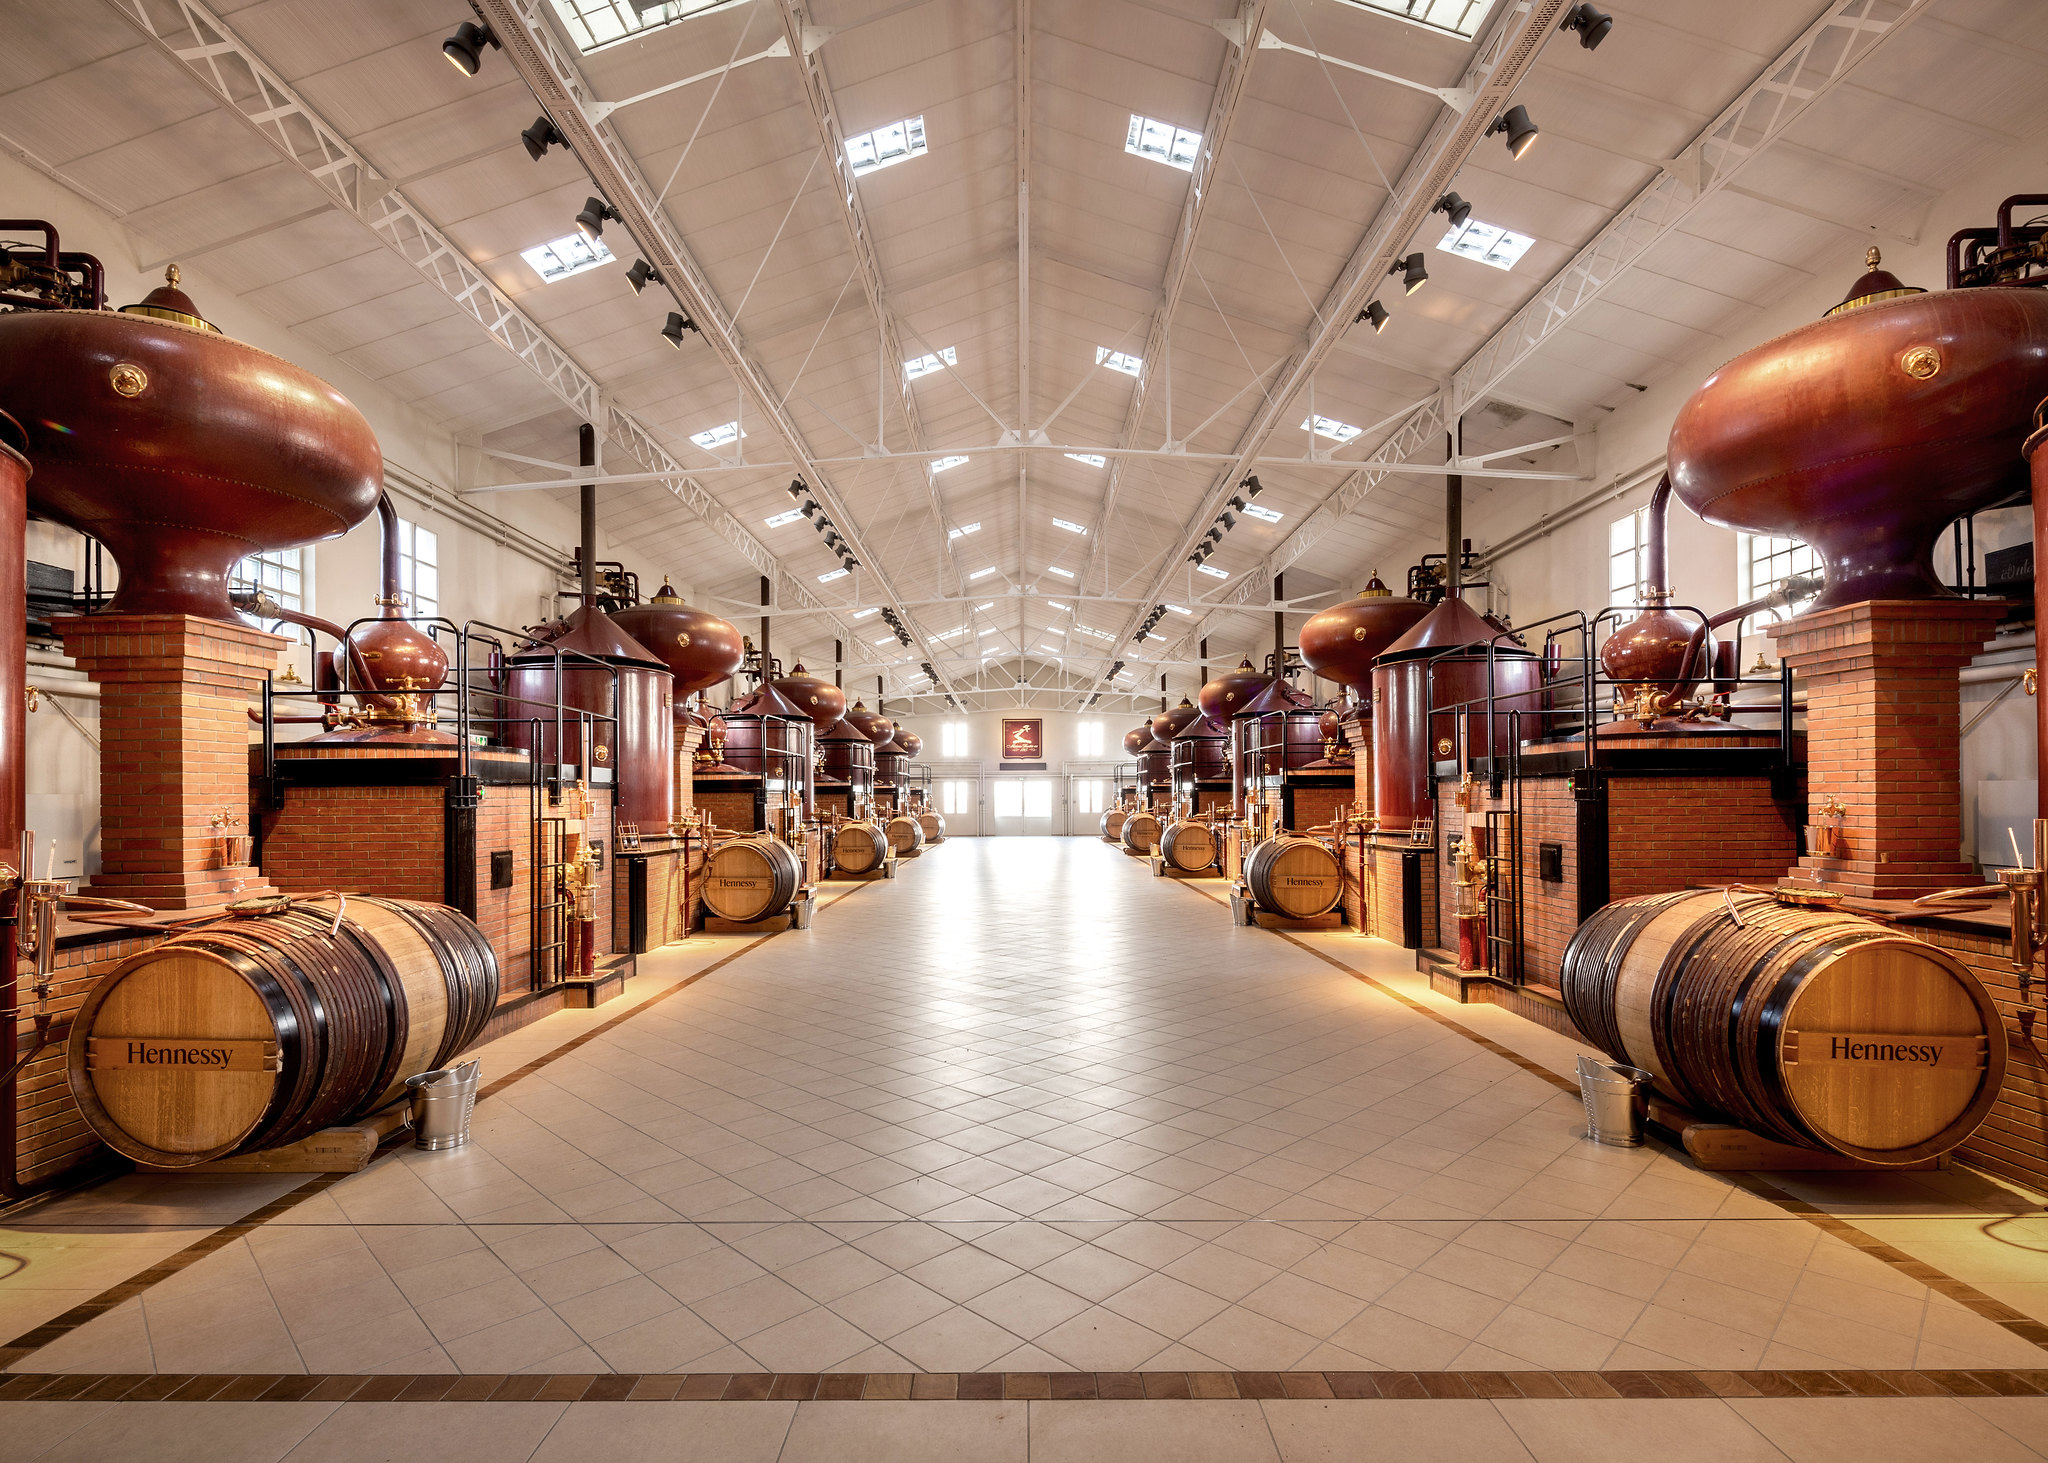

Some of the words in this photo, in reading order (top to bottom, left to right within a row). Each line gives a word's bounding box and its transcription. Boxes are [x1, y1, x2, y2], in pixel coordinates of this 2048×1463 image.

[719, 879, 757, 888] Hennessy
[1286, 877, 1325, 888] Hennessy
[127, 1042, 234, 1069] Hennessy
[1831, 1037, 1943, 1066] Hennessy
